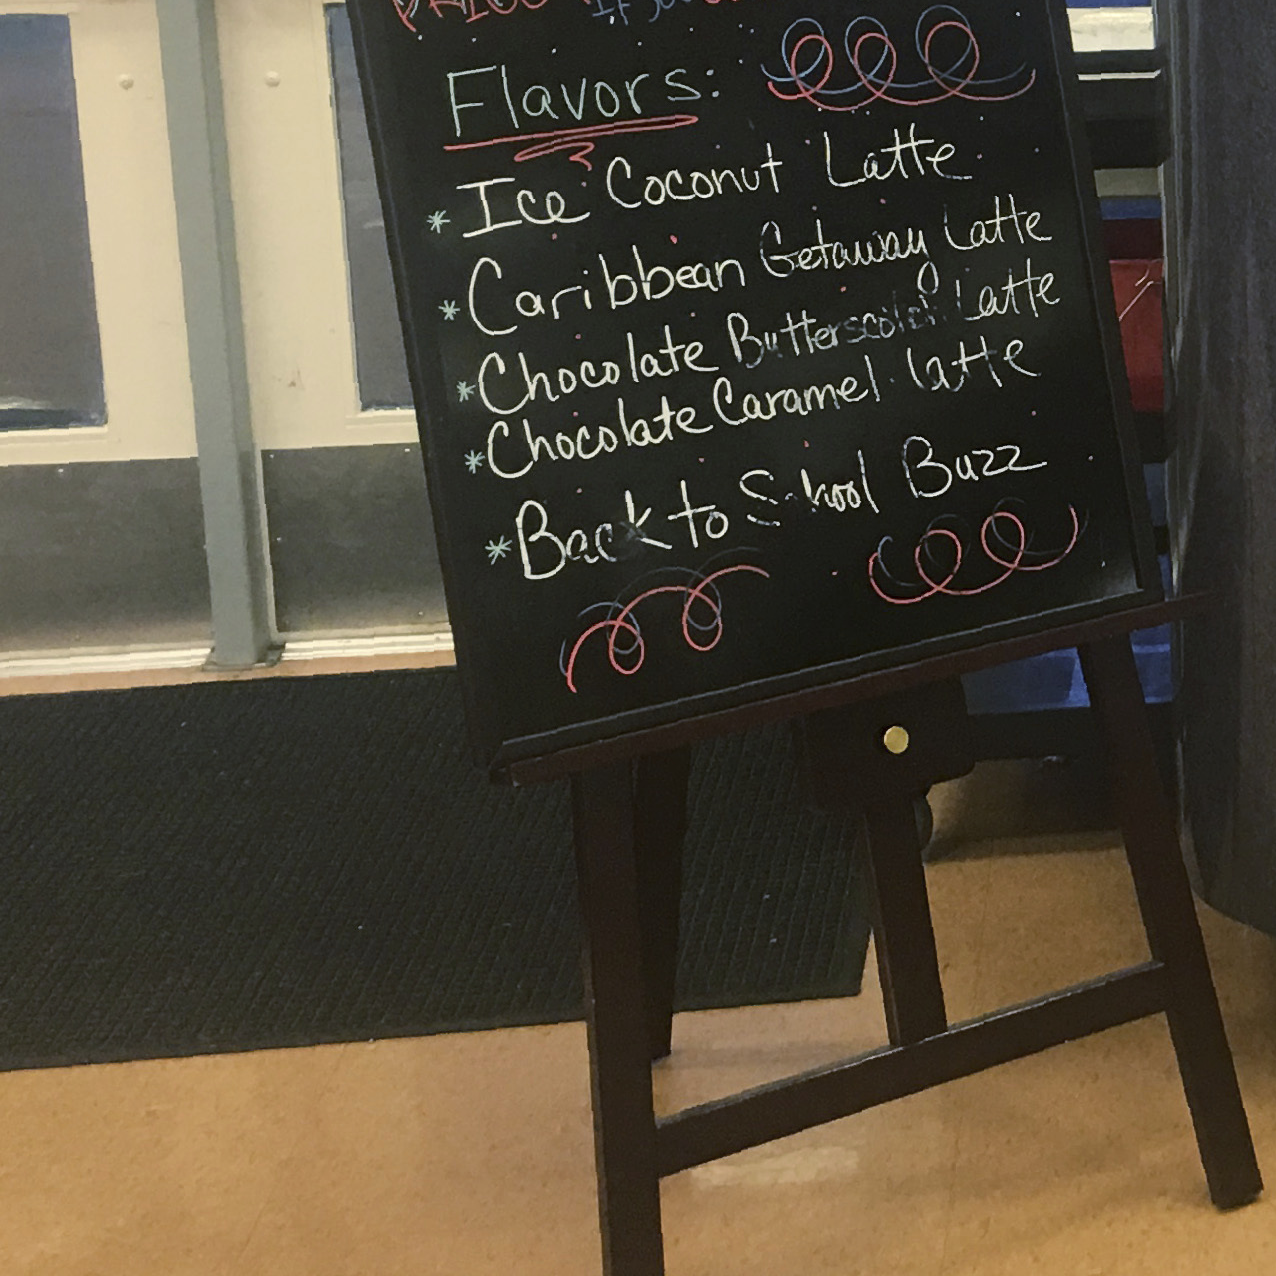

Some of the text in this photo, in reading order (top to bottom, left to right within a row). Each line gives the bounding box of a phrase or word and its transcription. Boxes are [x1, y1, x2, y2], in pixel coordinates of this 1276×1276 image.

[606, 142, 783, 208] Coconut
[823, 123, 974, 189] Latte
[469, 246, 747, 336] Caribbean
[477, 324, 722, 416] Chocolate
[486, 394, 714, 480] Chocolate
[712, 353, 882, 427] Caramel
[516, 490, 672, 579] Back
[668, 480, 729, 549] to
[902, 436, 1048, 498] Buzz
